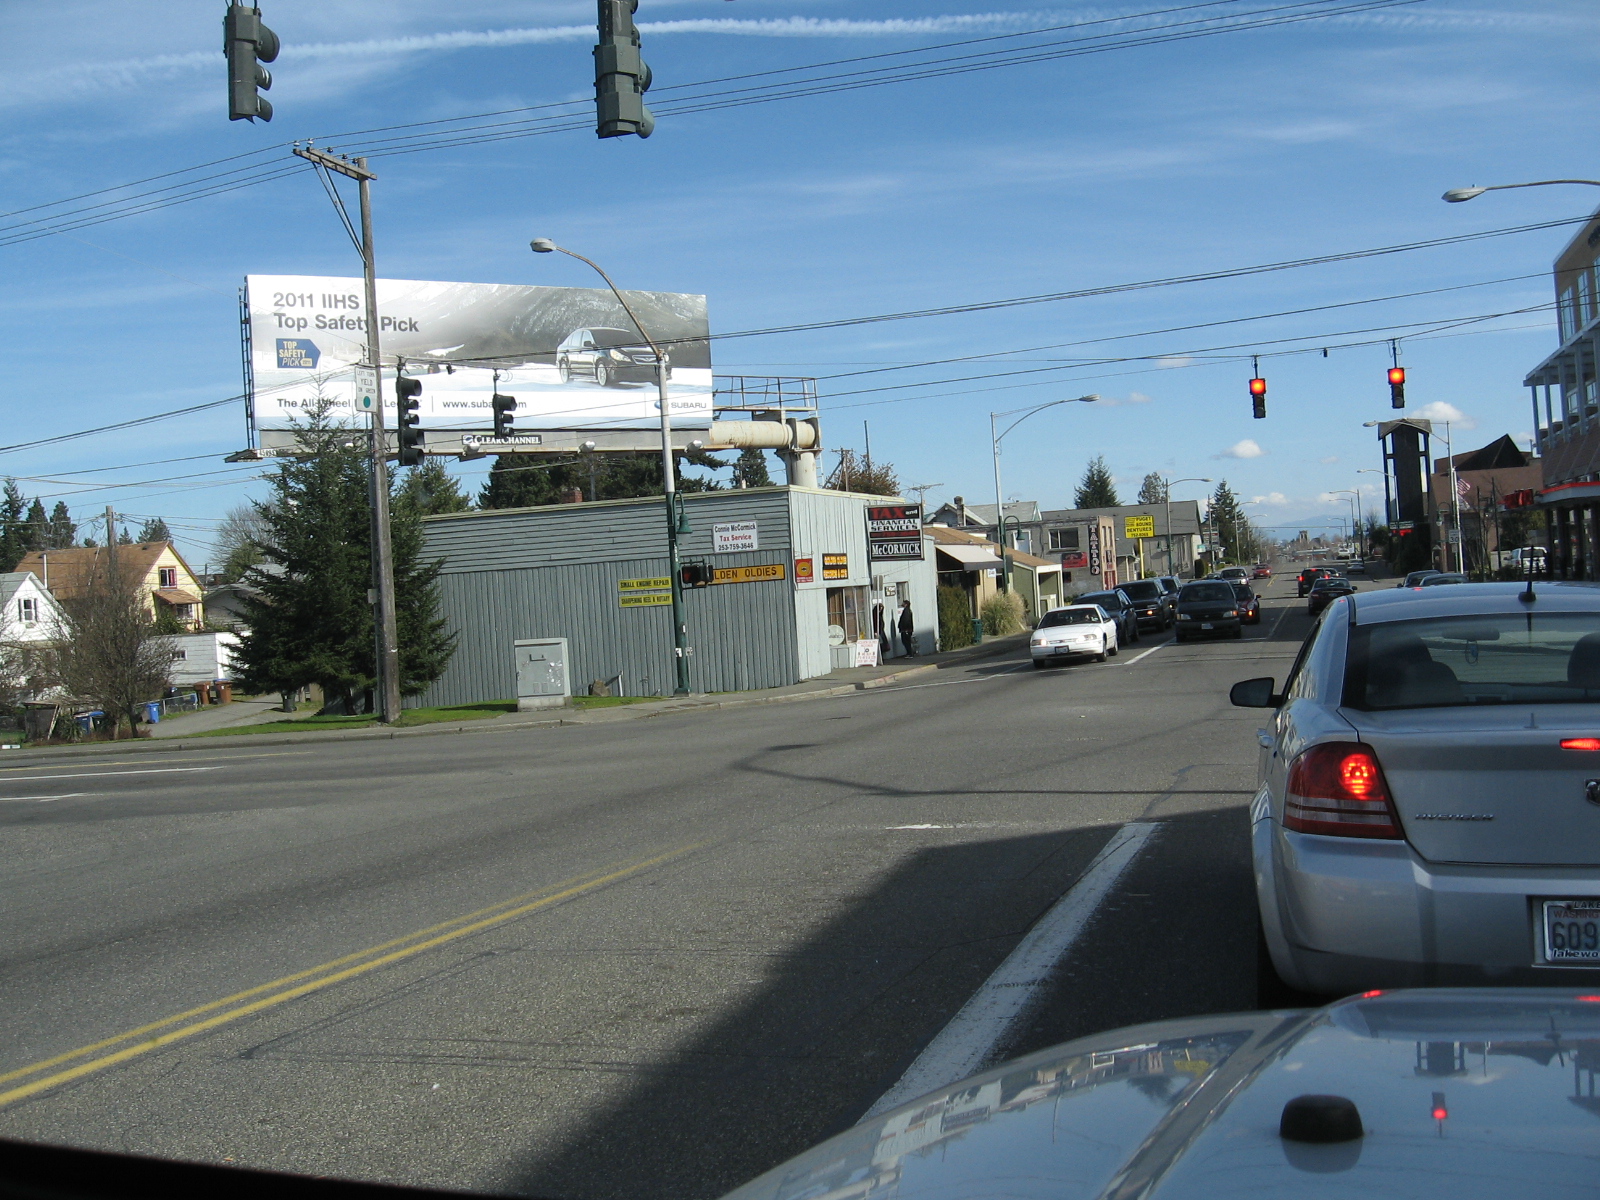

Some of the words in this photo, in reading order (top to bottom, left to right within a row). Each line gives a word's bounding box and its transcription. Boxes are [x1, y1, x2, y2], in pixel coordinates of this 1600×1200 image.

[273, 292, 314, 308] 2011
[322, 293, 360, 309] IIHS
[273, 312, 308, 332] Top
[380, 316, 419, 332] Pick
[282, 341, 297, 349] TOP
[279, 349, 306, 358] SAFETY
[282, 357, 300, 366] PICK
[277, 398, 297, 408] The
[870, 507, 905, 519] TAX
[715, 525, 730, 533] Connie
[730, 522, 756, 532] McCormick
[872, 543, 920, 555] McCORMICK
[1089, 524, 1100, 575] TATTOO
[714, 569, 738, 580] LDEN
[744, 566, 777, 578] OLDIES
[1552, 922, 1598, 949] 609
